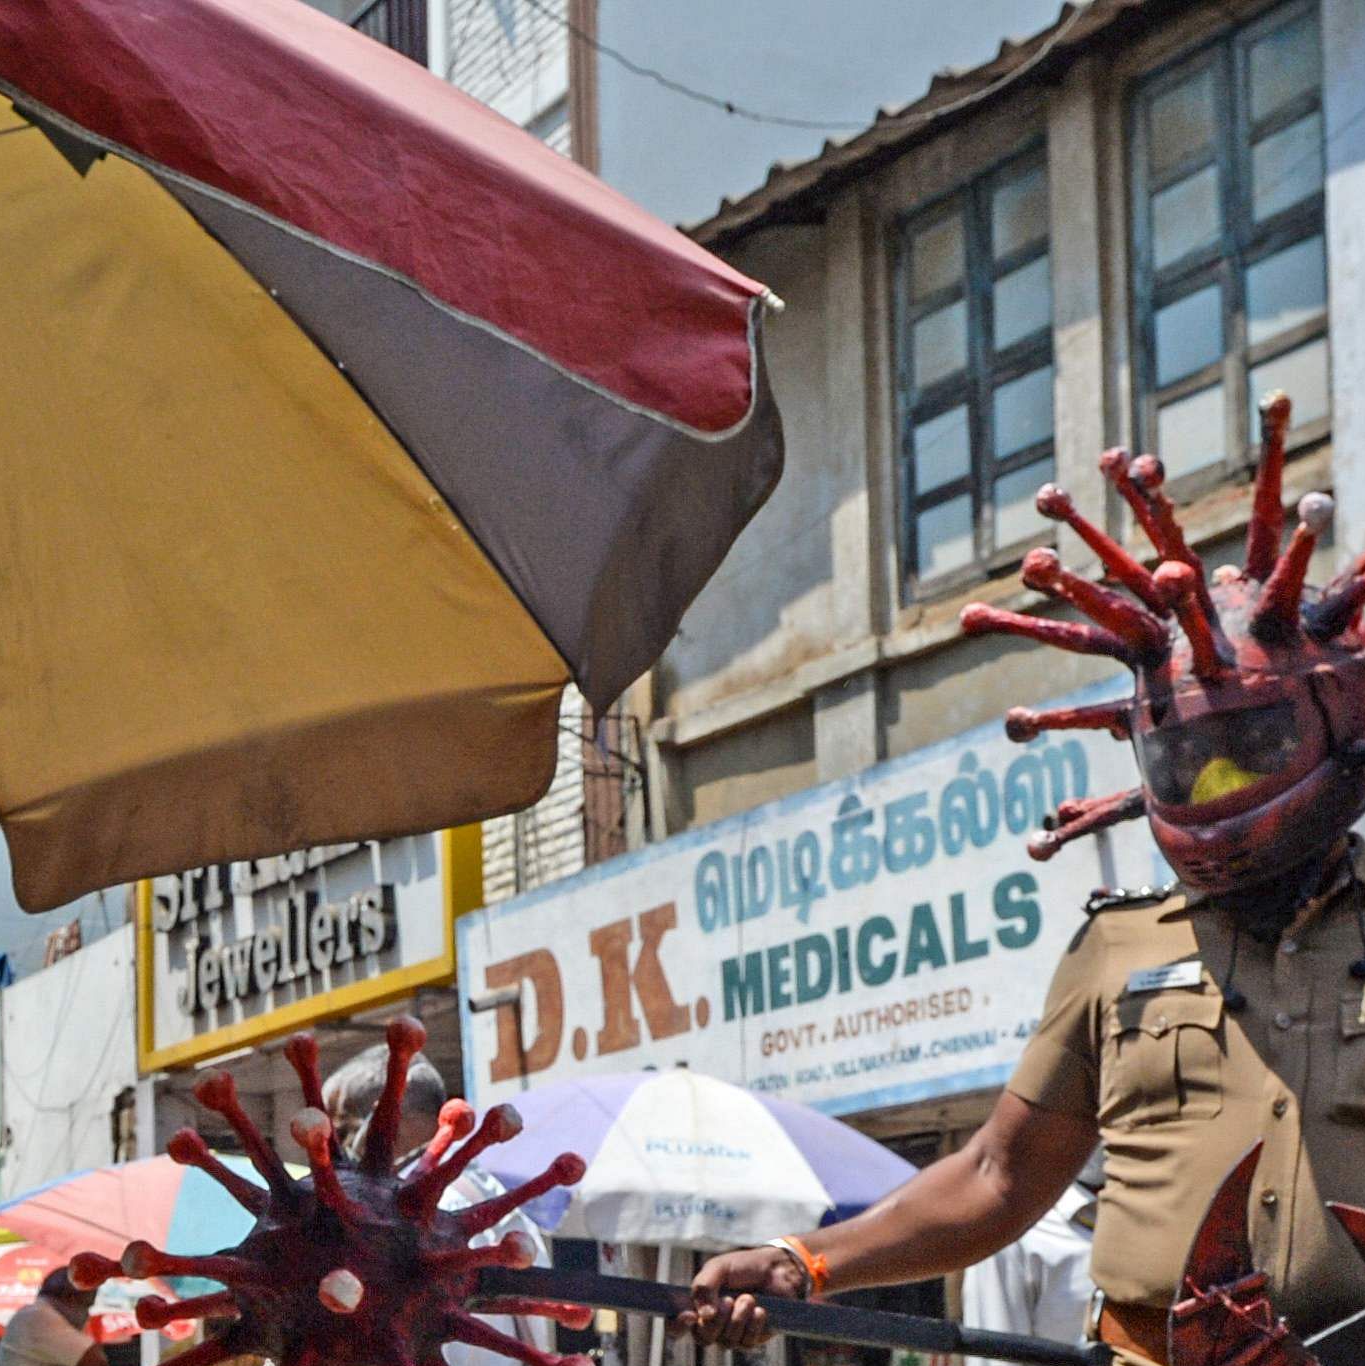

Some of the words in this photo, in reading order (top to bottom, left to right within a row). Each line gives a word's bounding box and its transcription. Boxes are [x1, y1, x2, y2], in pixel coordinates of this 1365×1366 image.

[179, 886, 385, 1016] Jewellers
[484, 900, 711, 1084] D.K.
[721, 871, 1042, 1022] MEDICALS
[760, 1022, 828, 1058] GOVT.
[833, 987, 974, 1042] AUTHORISED
